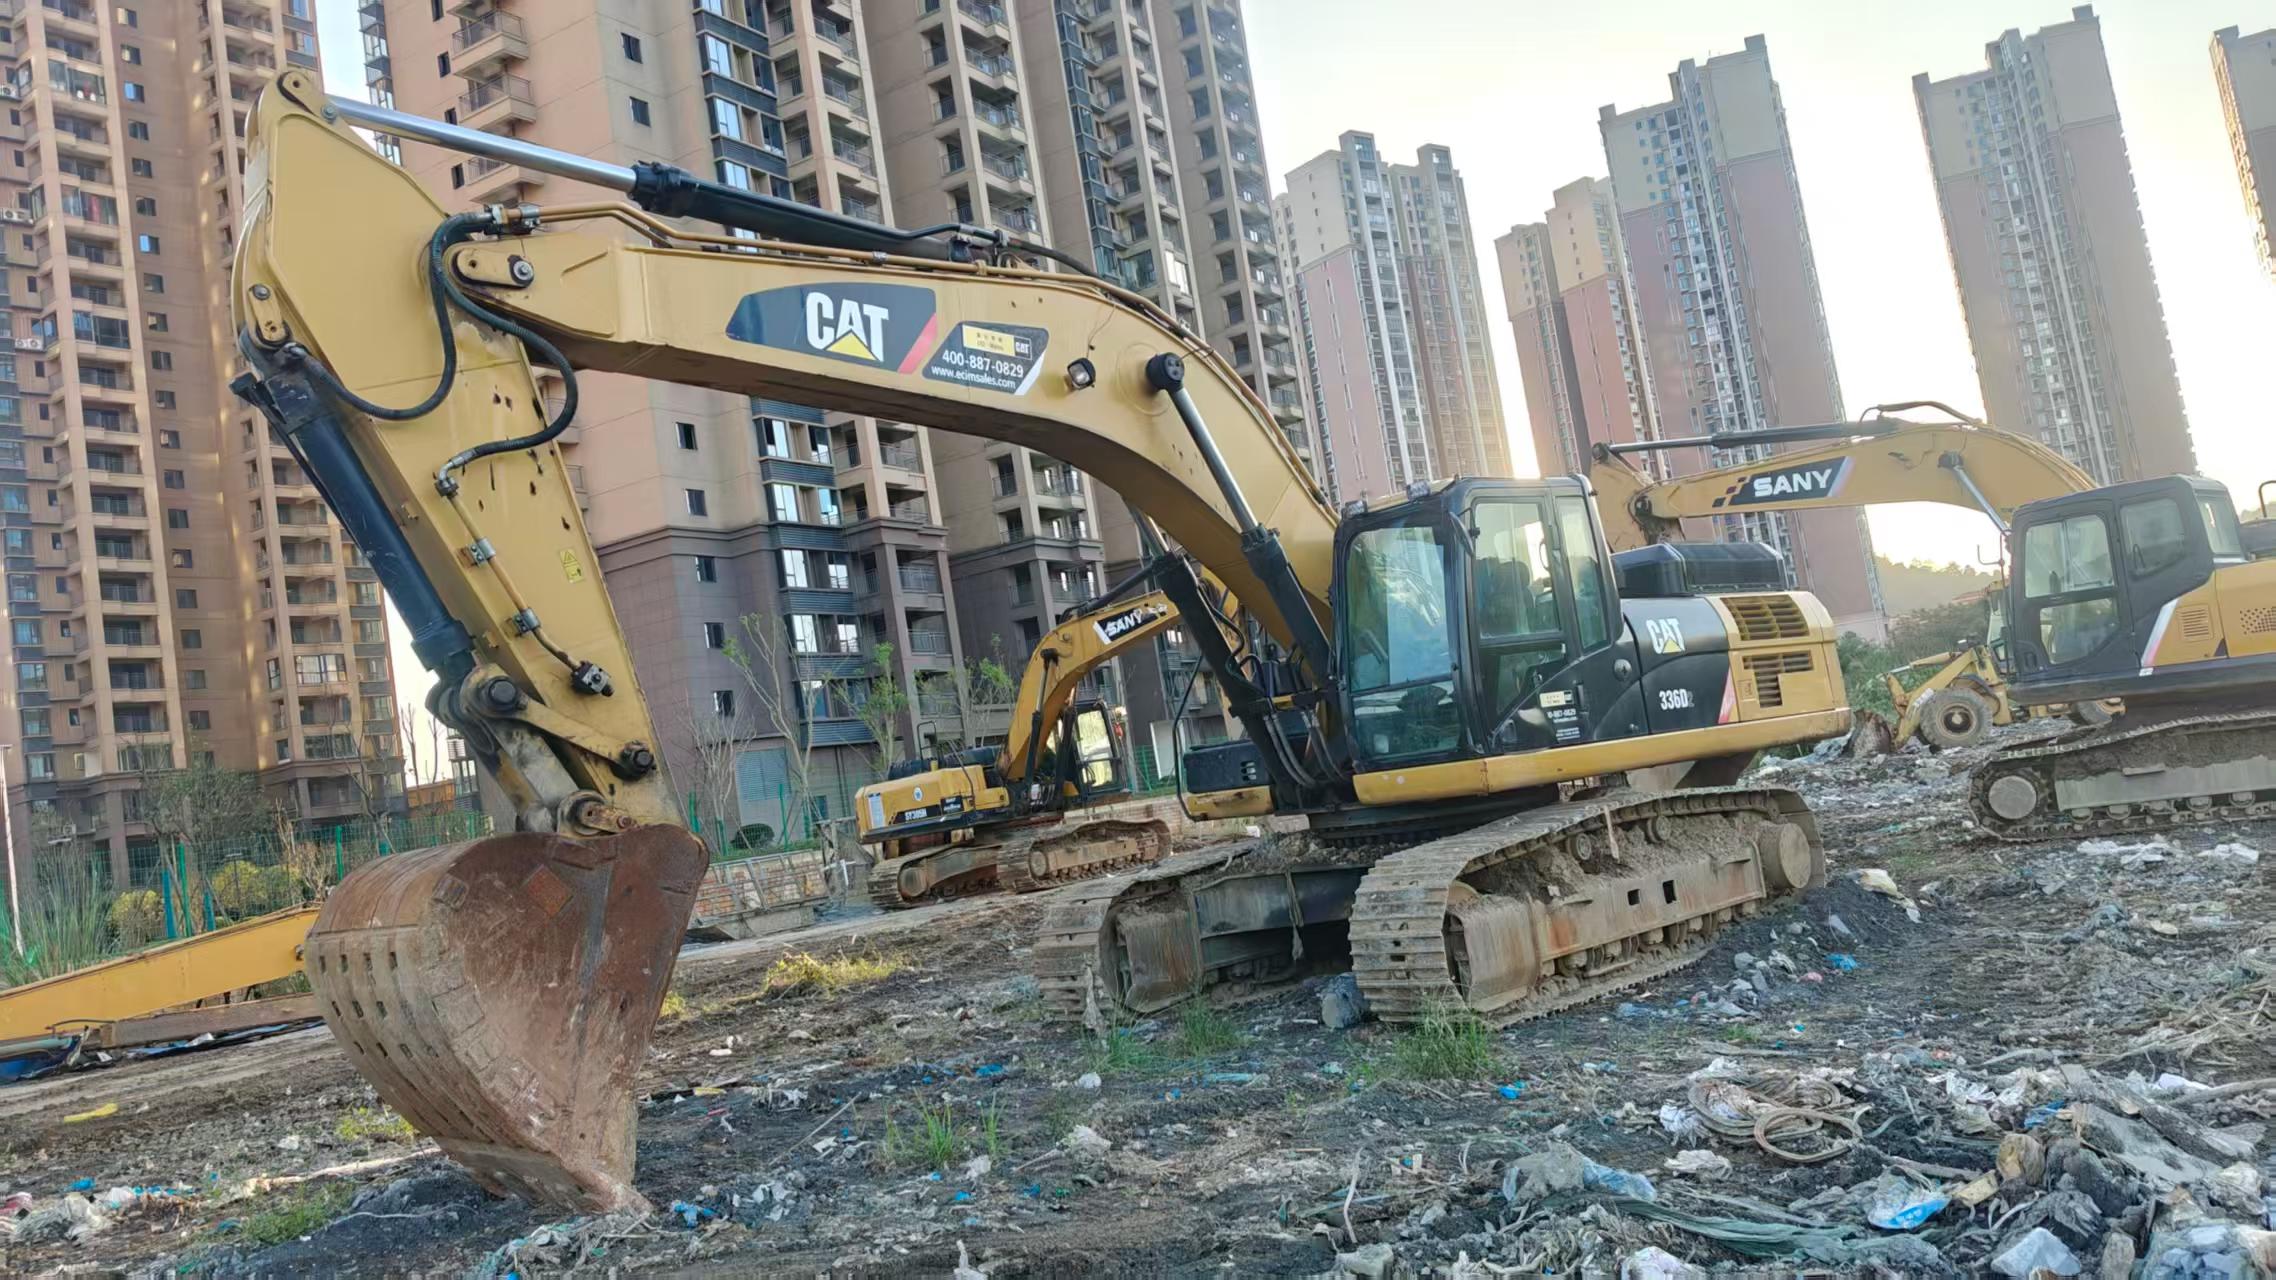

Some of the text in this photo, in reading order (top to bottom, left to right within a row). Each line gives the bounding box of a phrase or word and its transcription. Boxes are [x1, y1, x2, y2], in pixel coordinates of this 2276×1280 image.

[806, 291, 889, 362] CAT
[1015, 341, 1030, 355] CAT
[931, 365, 1016, 390] www.ecimsales.com
[941, 349, 1024, 378] 400-887-0829
[1753, 468, 1832, 497] SANY
[1105, 608, 1143, 637] SANY
[1645, 618, 1685, 654] CAT
